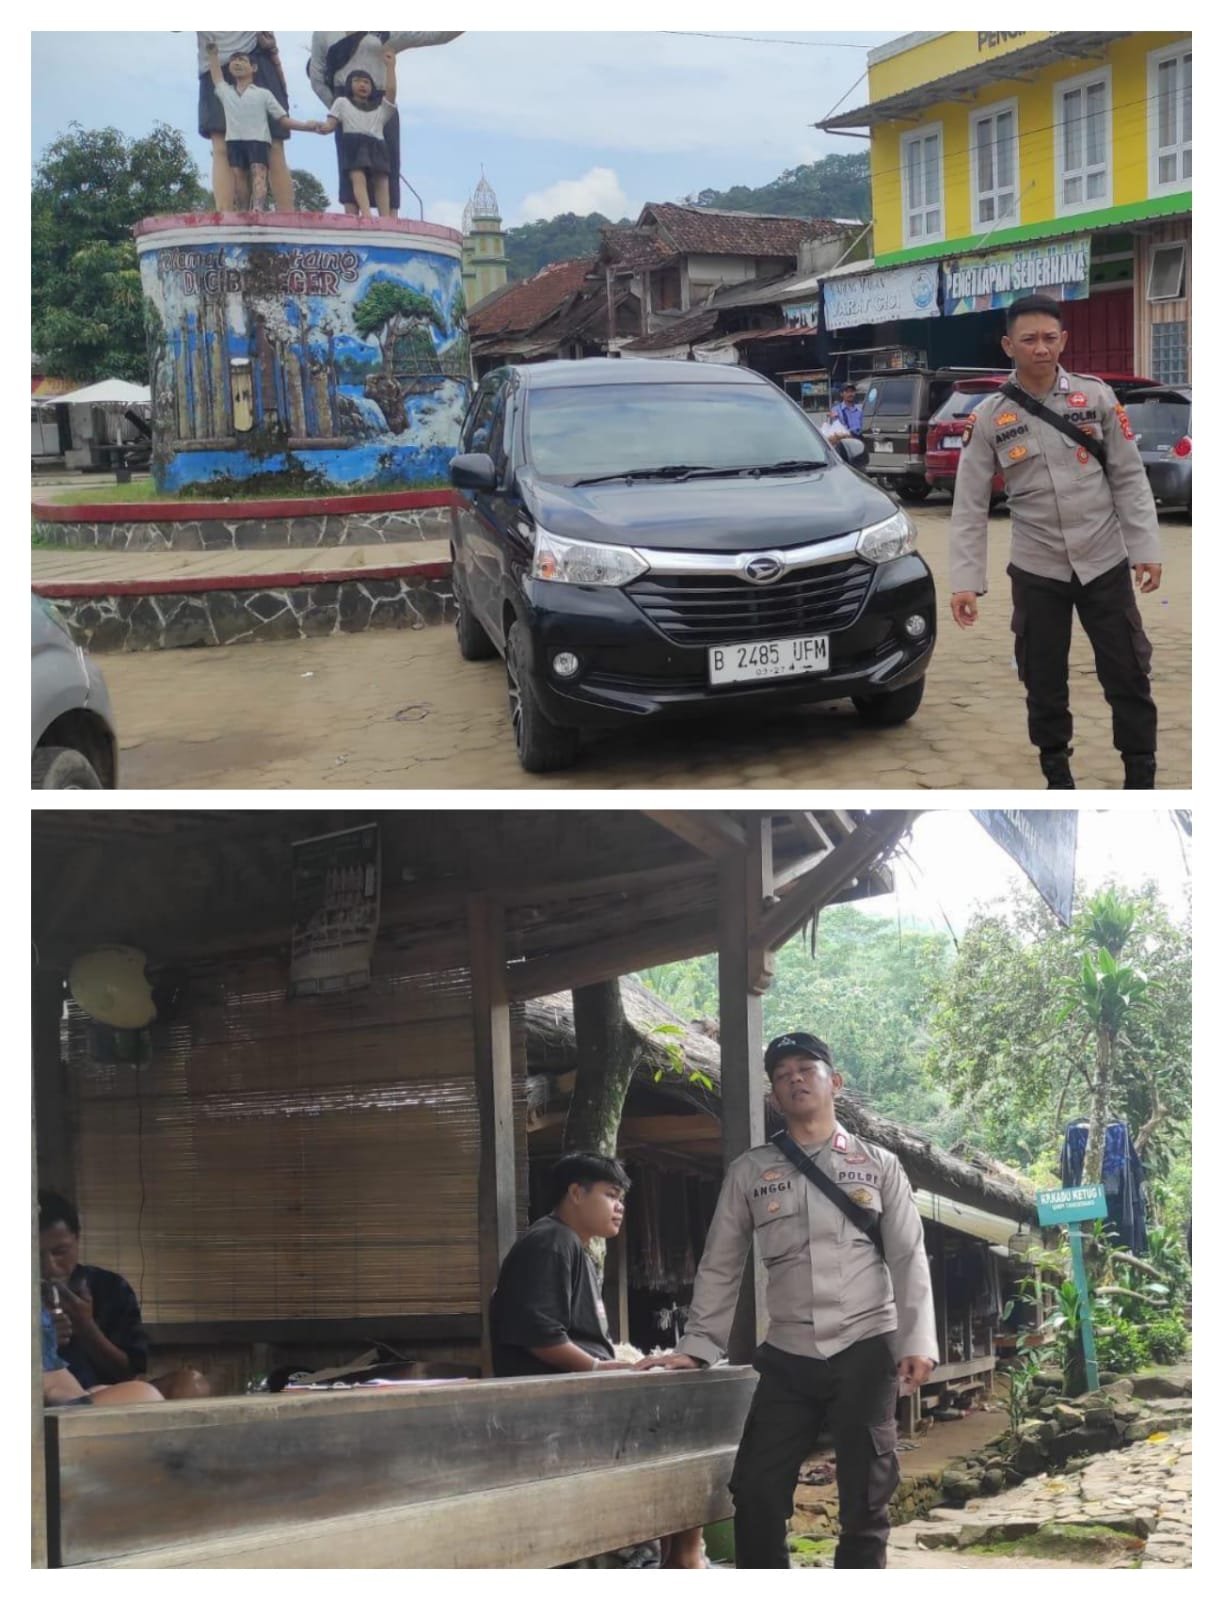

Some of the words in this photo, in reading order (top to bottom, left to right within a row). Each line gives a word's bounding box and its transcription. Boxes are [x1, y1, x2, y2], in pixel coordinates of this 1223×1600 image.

[1012, 250, 1086, 291] SEDERHANA
[1063, 410, 1097, 422] POLRI
[995, 425, 1029, 444] ANGGI
[713, 650, 725, 671] B
[737, 643, 780, 668] 2485
[793, 638, 827, 662] UFM
[838, 1170, 879, 1184] POLRI
[753, 1180, 792, 1199] ANGGI
